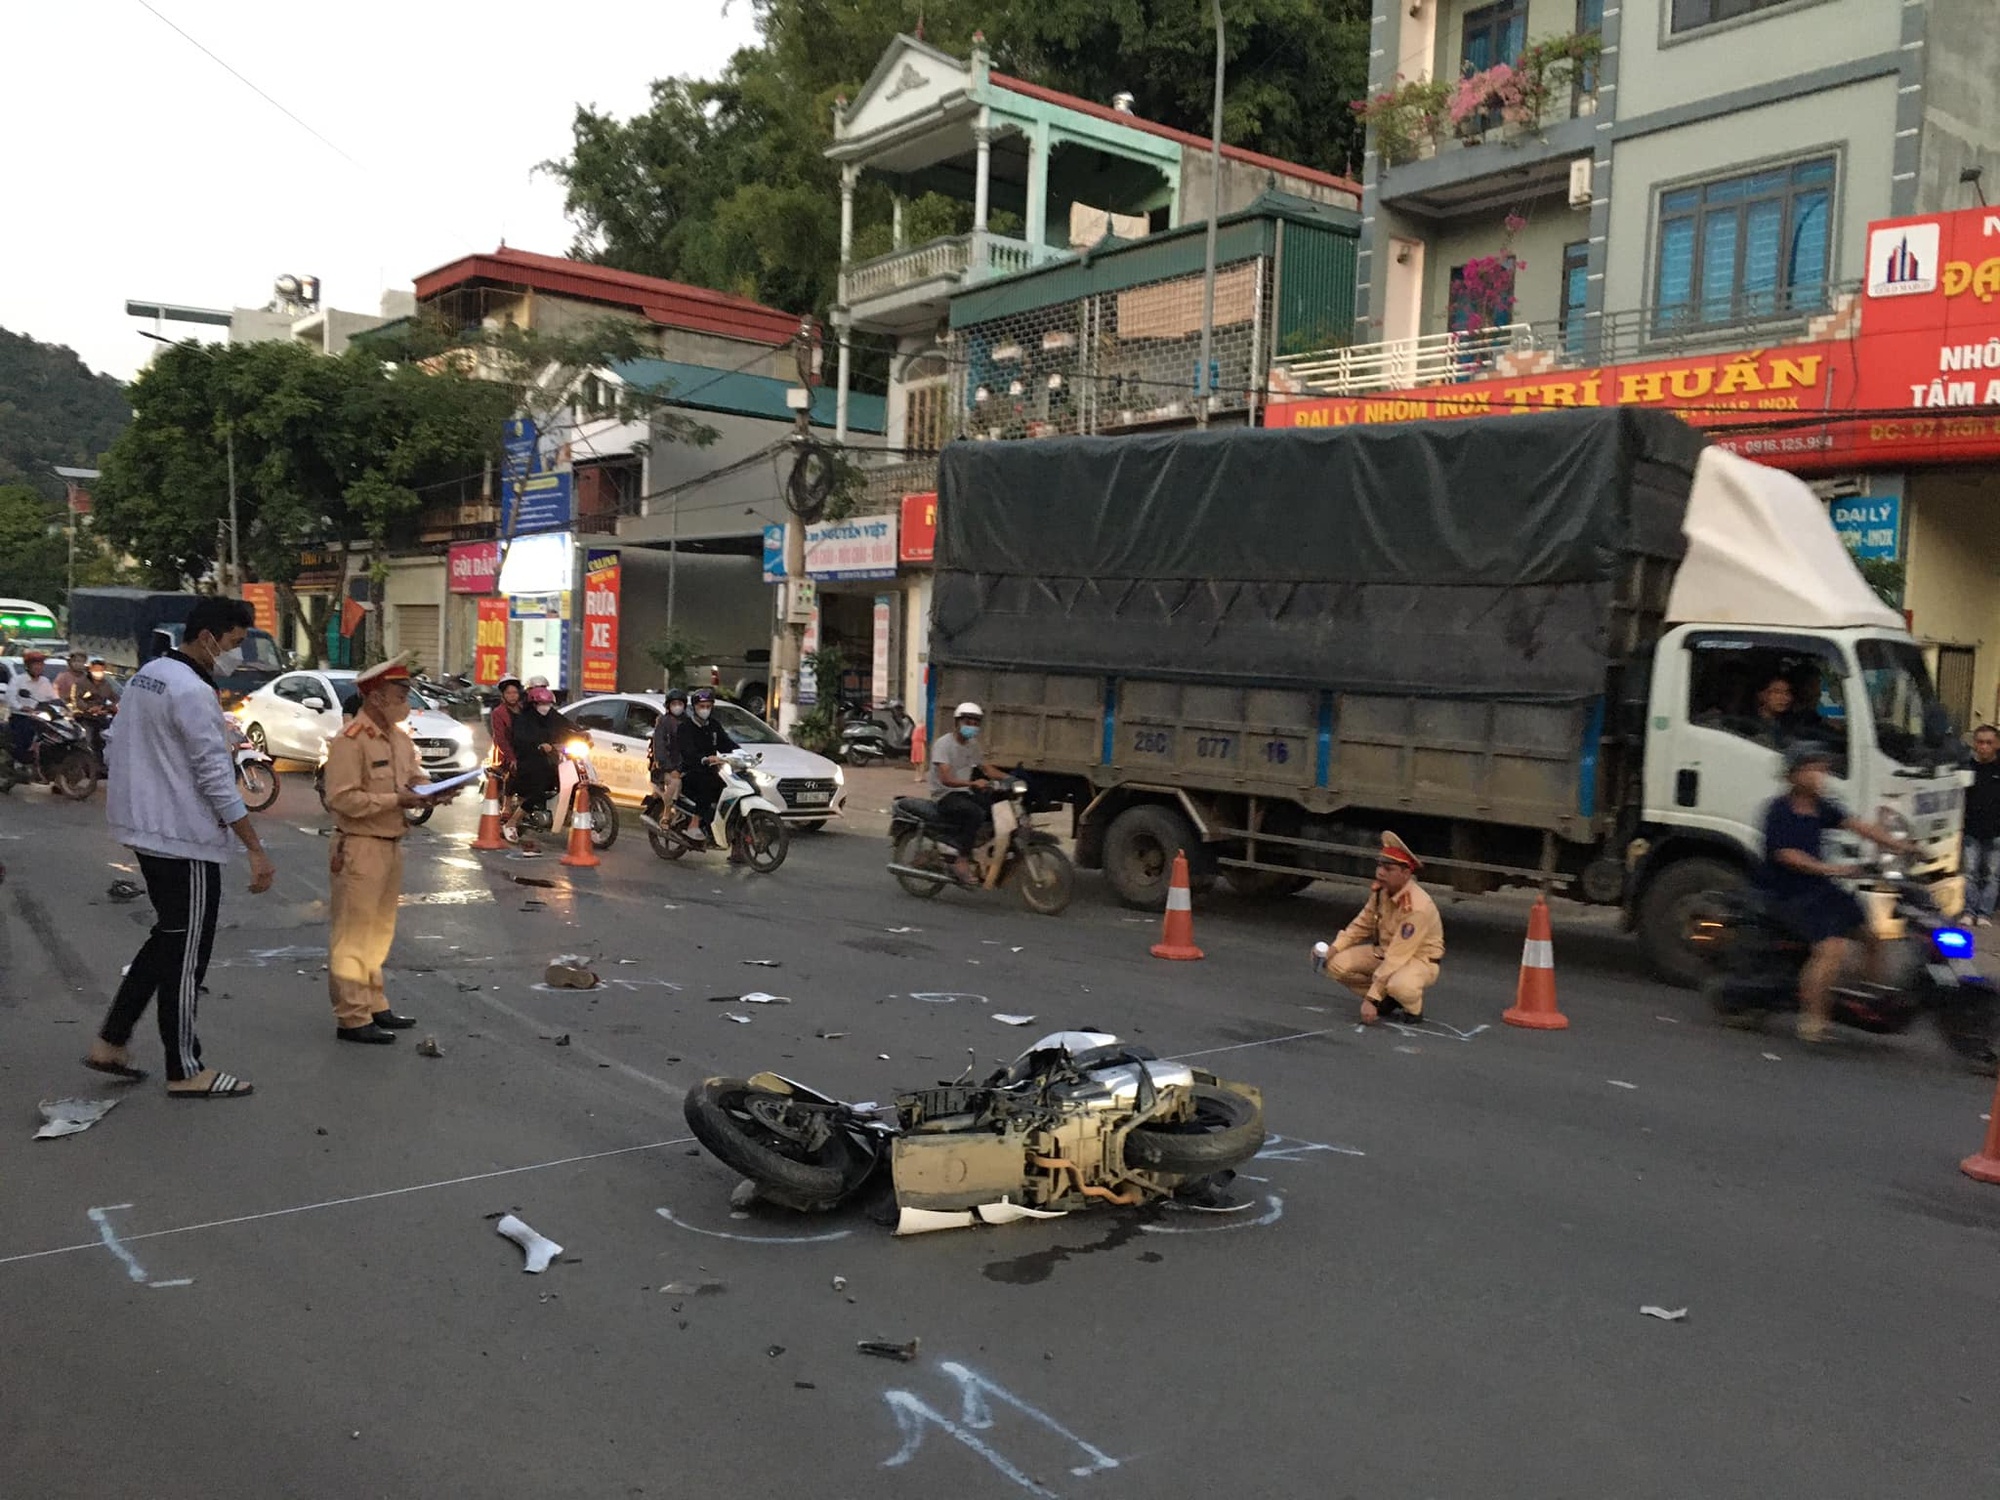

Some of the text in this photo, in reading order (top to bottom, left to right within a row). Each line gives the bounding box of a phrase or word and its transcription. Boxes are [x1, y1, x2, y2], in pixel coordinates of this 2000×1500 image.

[1435, 391, 1492, 417] INOX
[1503, 368, 1603, 415] TRÍ
[1617, 349, 1823, 405] HUẤN
[1758, 396, 1799, 410] INOX
[590, 622, 611, 648] XE
[481, 653, 501, 682] XE
